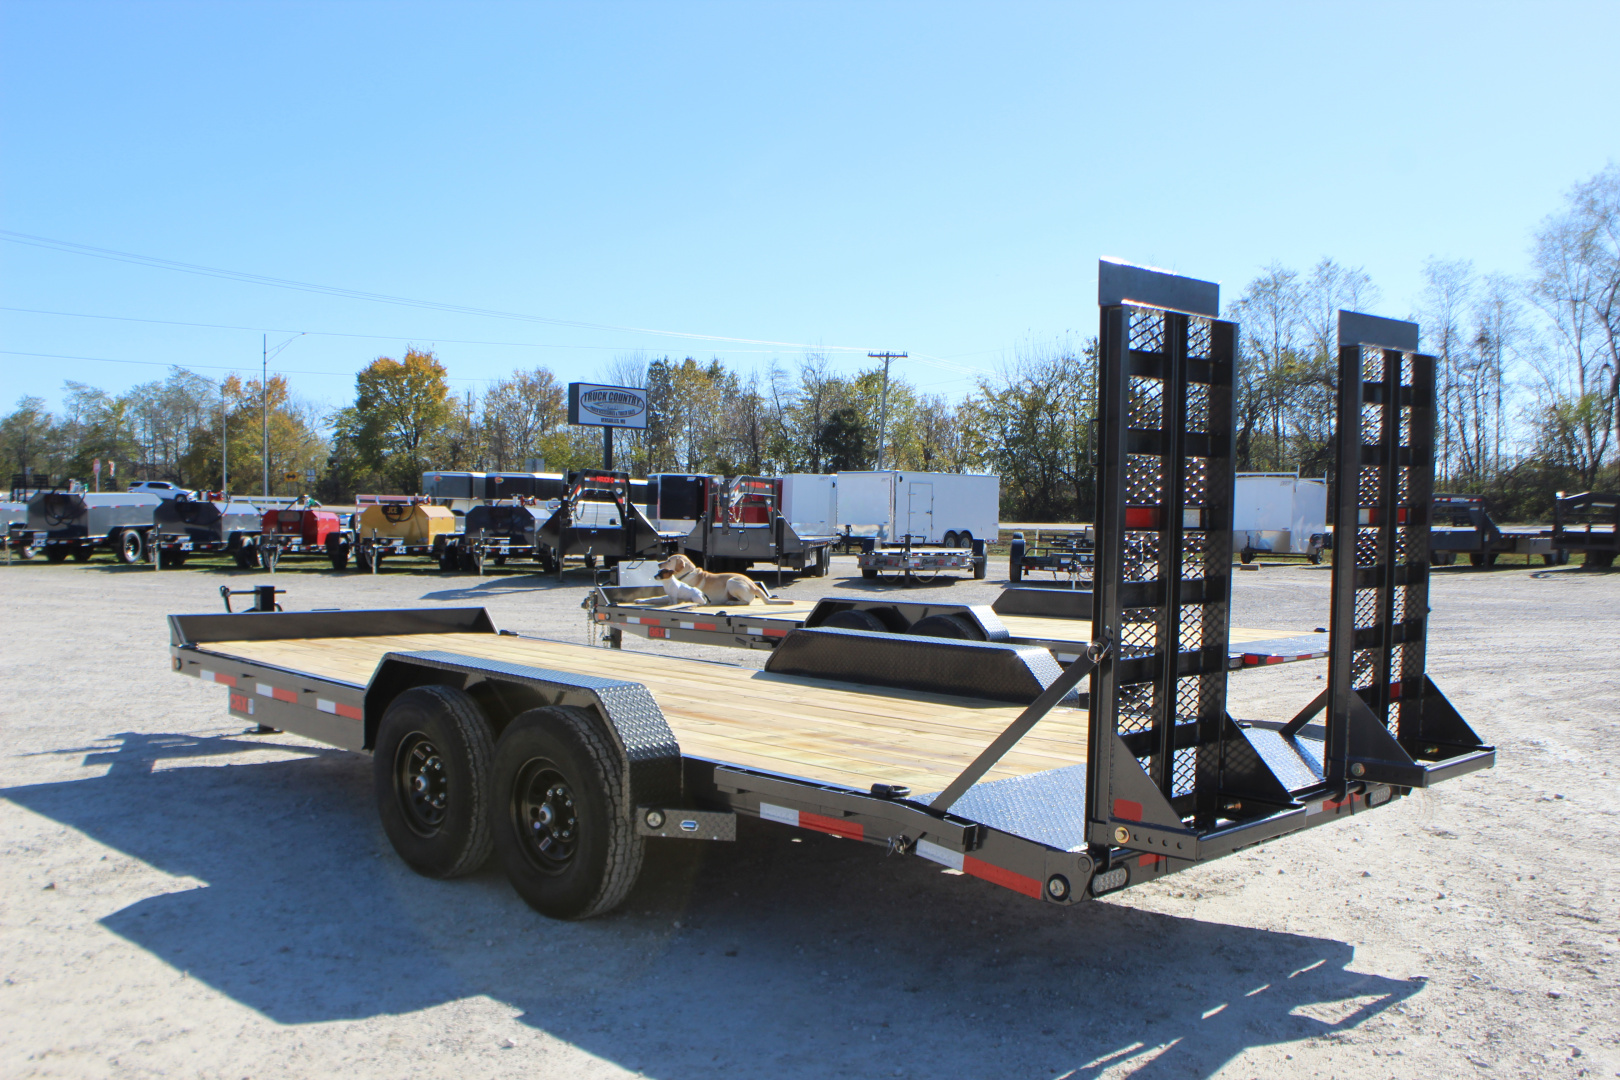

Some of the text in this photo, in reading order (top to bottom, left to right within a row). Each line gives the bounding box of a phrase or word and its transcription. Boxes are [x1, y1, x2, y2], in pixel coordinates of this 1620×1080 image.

[584, 392, 642, 406] TRUCK COUNTRY
[31, 538, 47, 547] JCE
[180, 542, 194, 551] JCE
[394, 545, 407, 554] JCE
